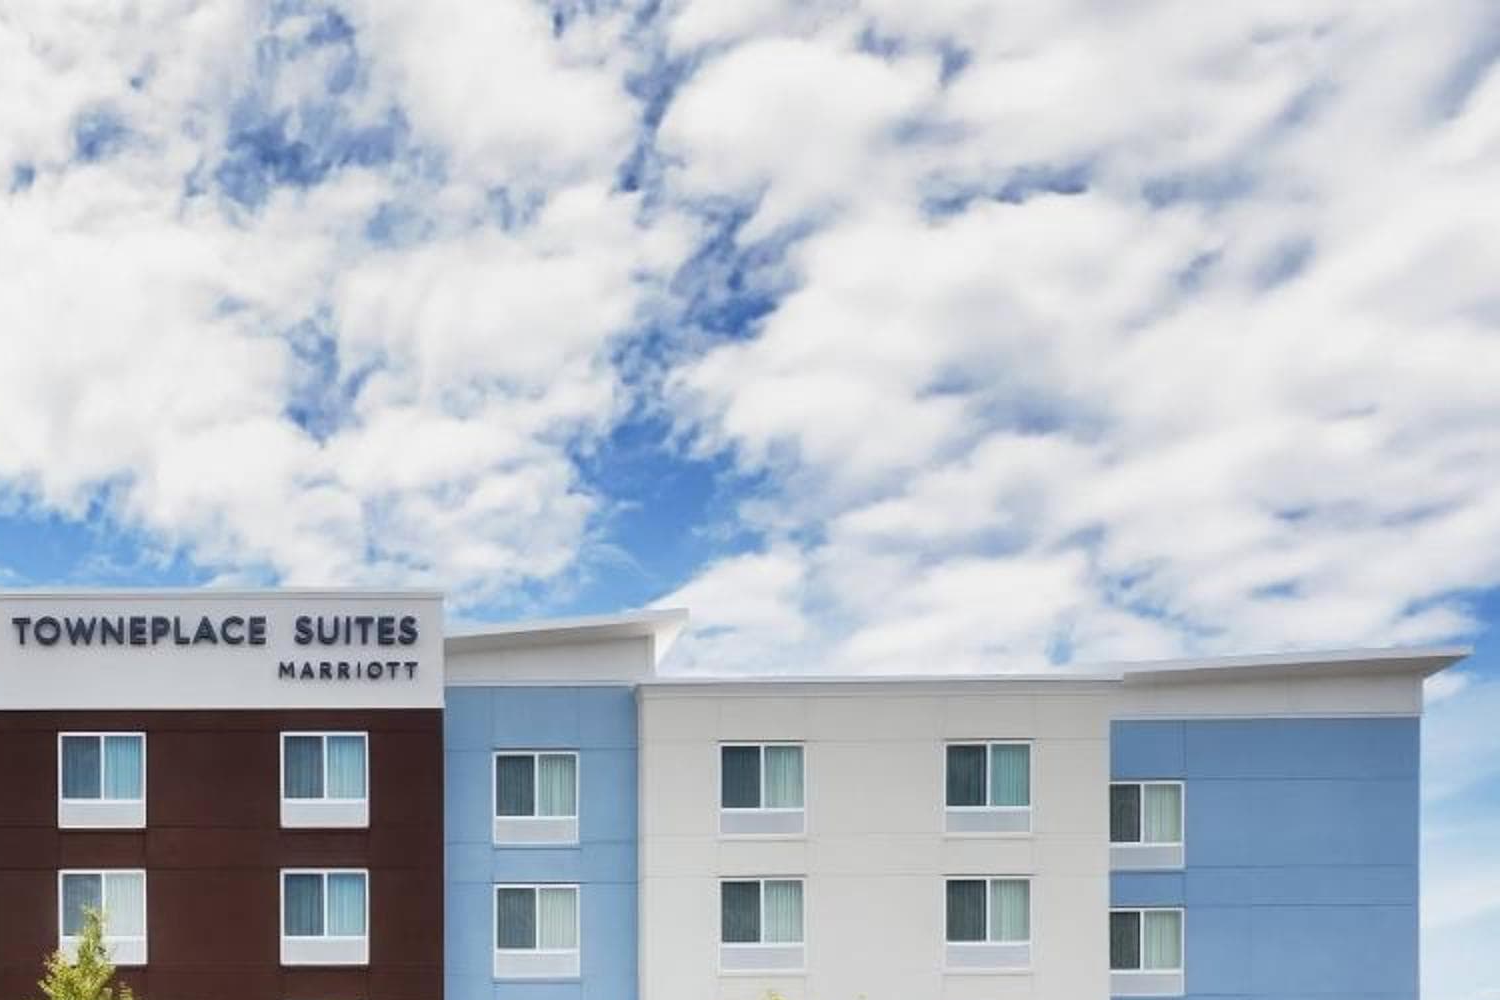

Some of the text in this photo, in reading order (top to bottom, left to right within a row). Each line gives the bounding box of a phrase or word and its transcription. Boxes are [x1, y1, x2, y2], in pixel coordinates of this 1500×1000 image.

[11, 615, 419, 647] TOWNEPLACE SUITES
[277, 661, 419, 681] MARRIOTT
